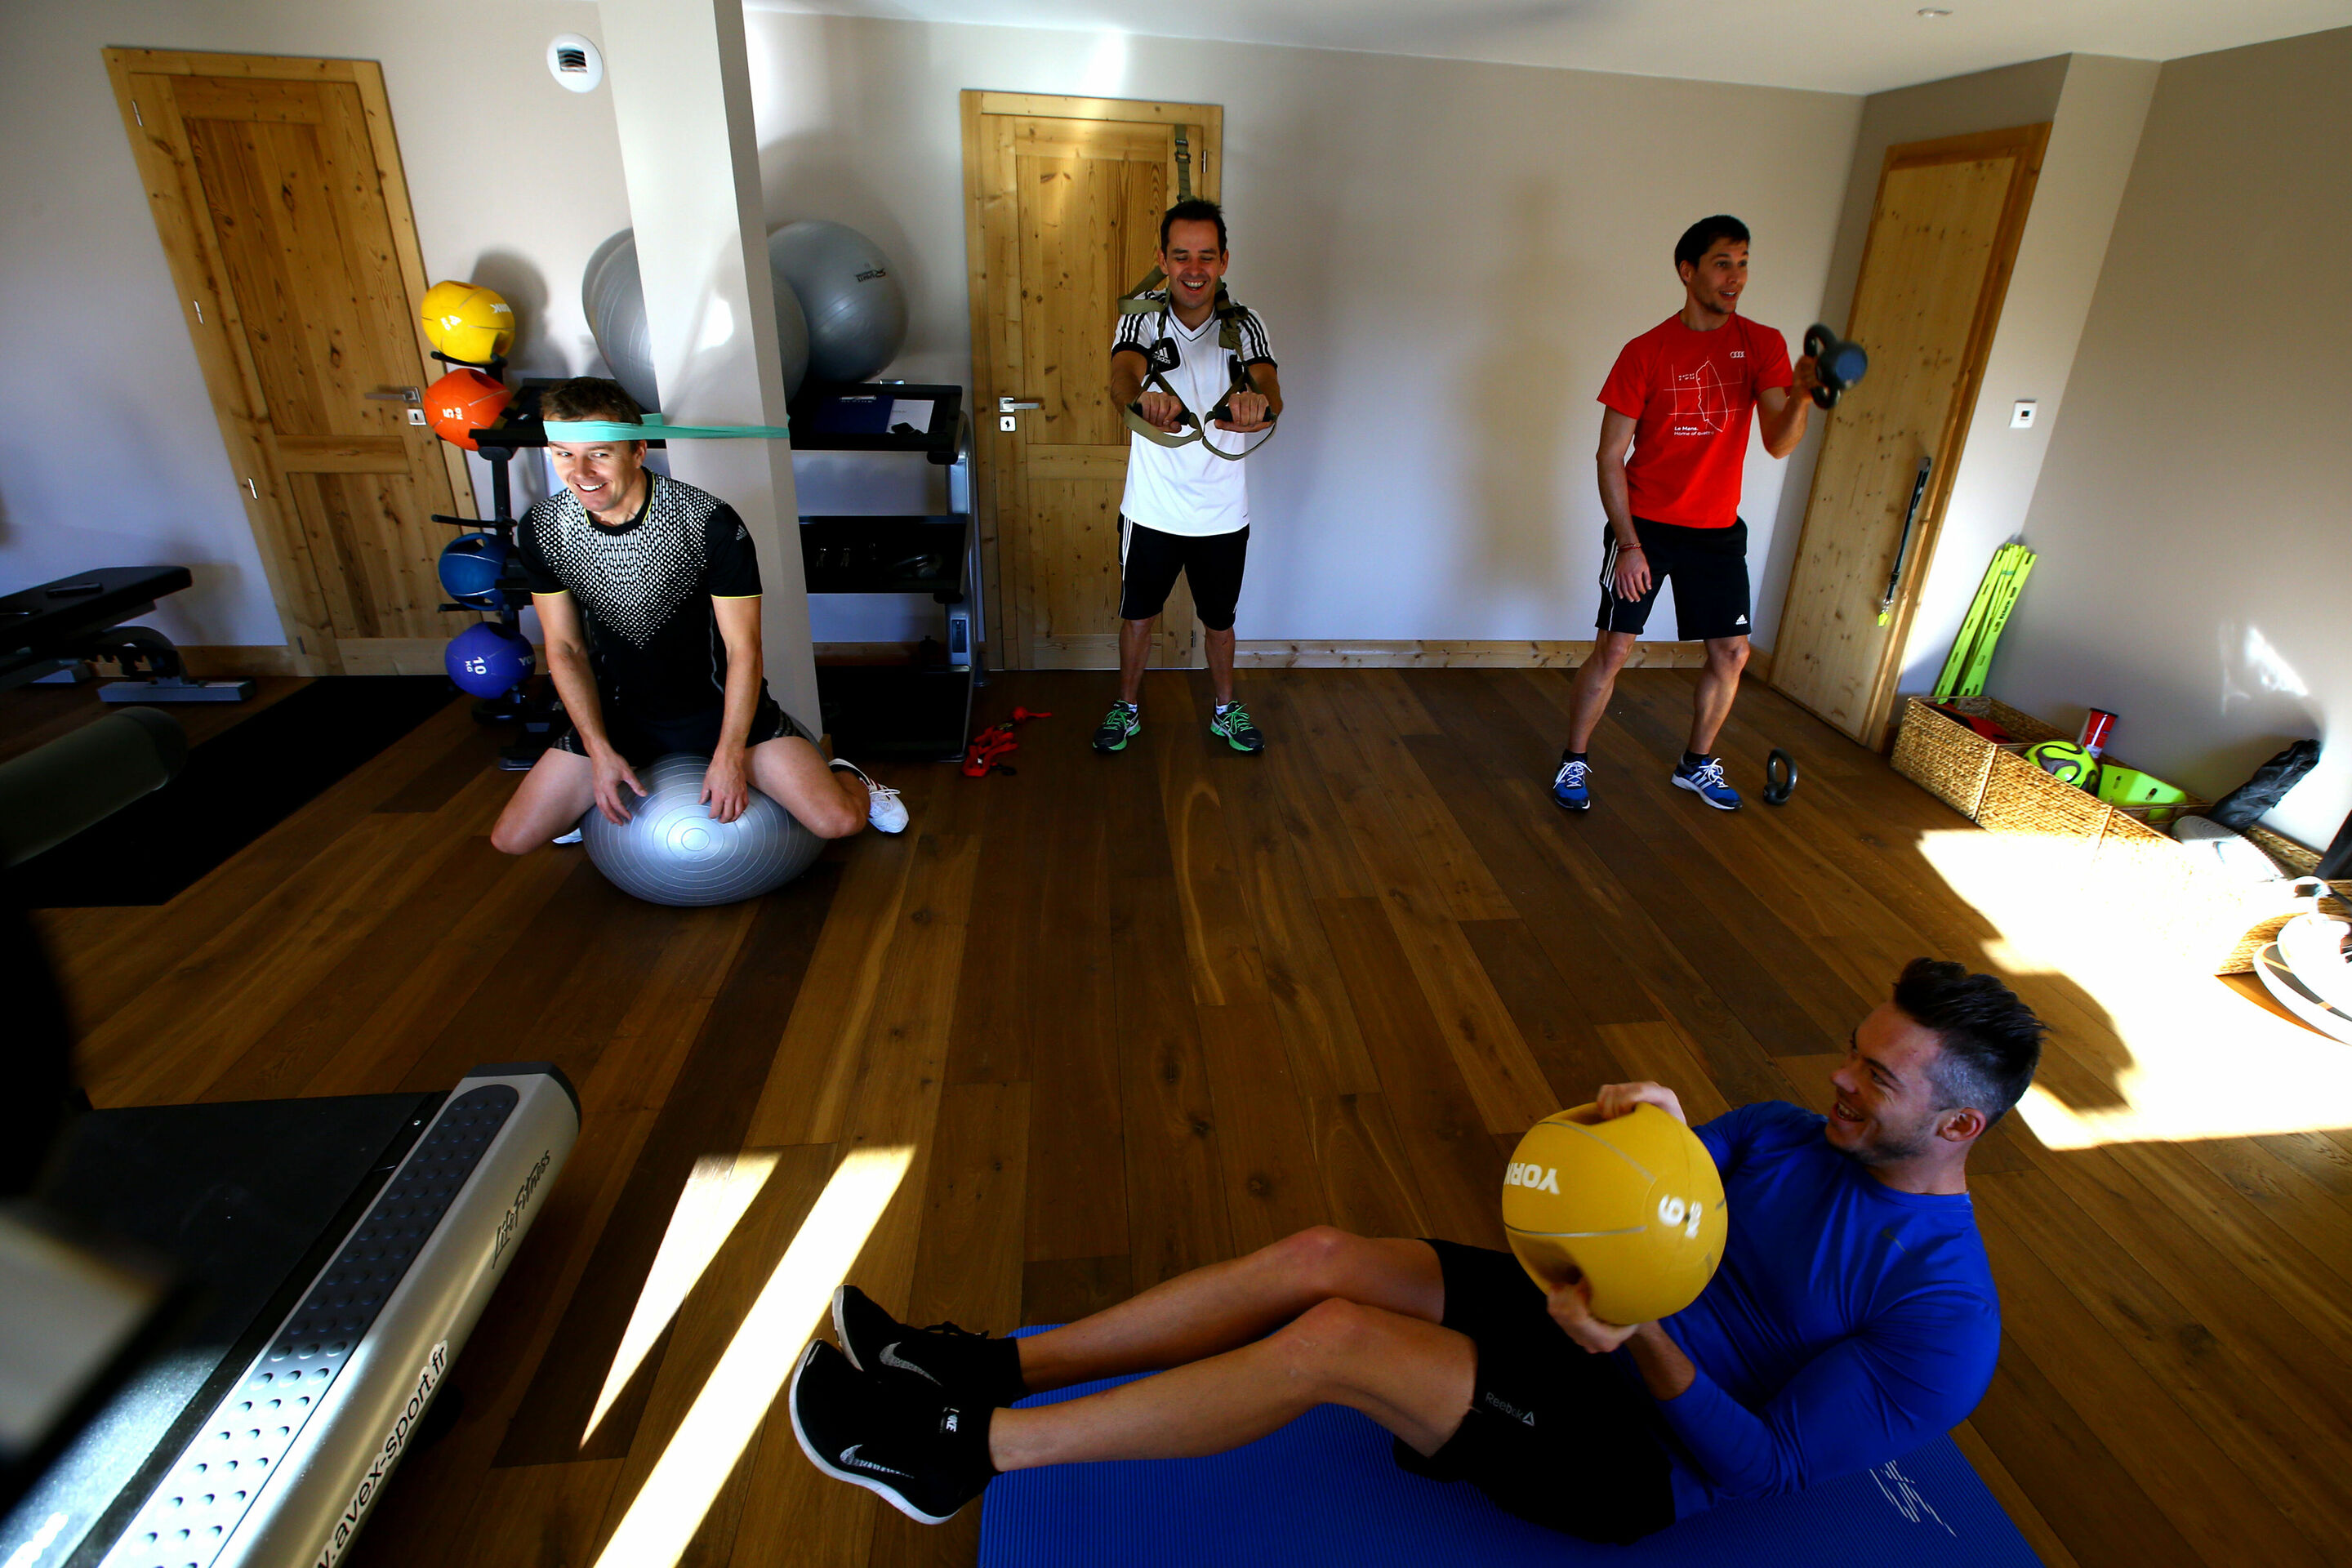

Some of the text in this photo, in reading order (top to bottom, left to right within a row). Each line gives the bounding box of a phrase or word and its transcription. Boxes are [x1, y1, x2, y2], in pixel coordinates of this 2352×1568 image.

[442, 408, 454, 418] 5
[455, 407, 464, 420] KG
[473, 656, 488, 675] 10
